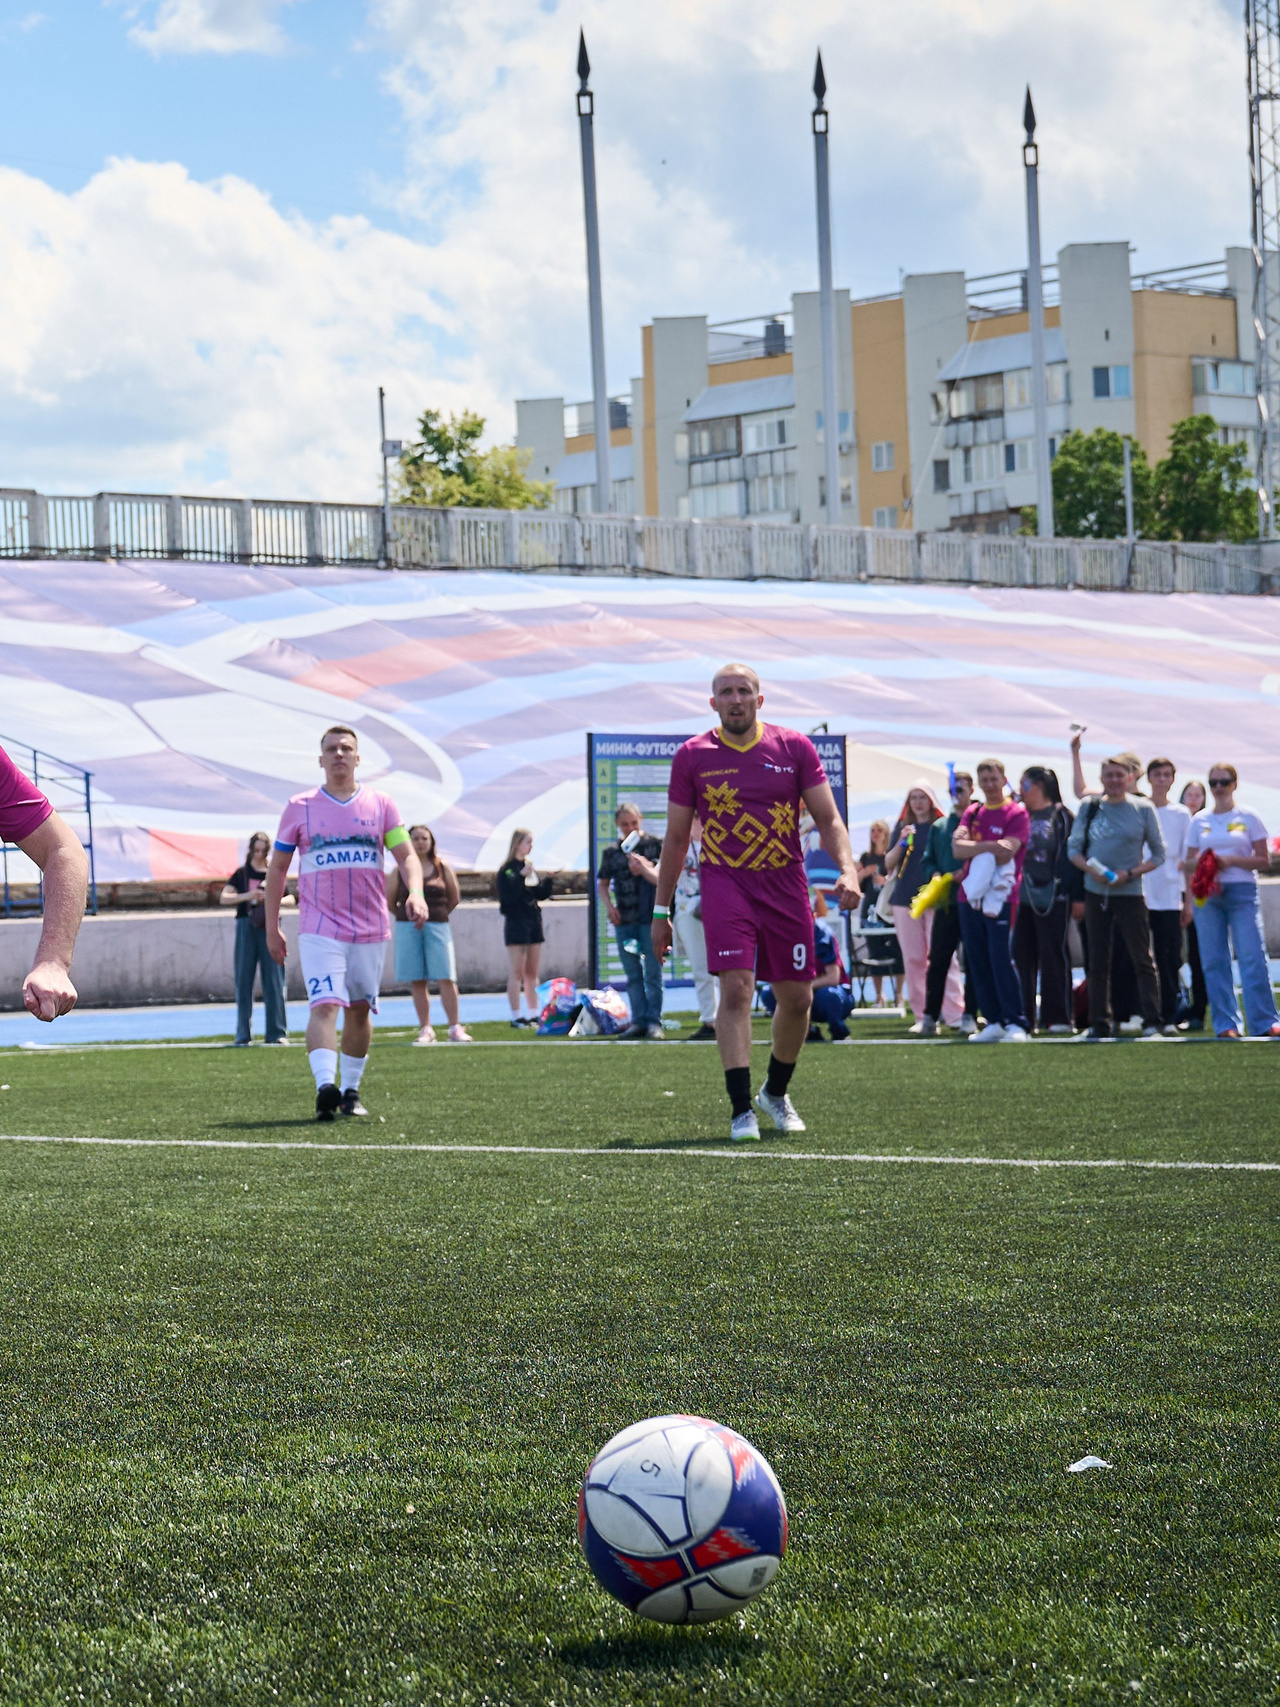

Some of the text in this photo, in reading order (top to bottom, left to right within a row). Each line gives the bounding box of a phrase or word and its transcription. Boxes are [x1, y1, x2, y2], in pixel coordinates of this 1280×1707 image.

[315, 850, 377, 866] САМАРА
[792, 943, 807, 970] 9
[308, 974, 333, 996] 21
[640, 1459, 662, 1478] 5
